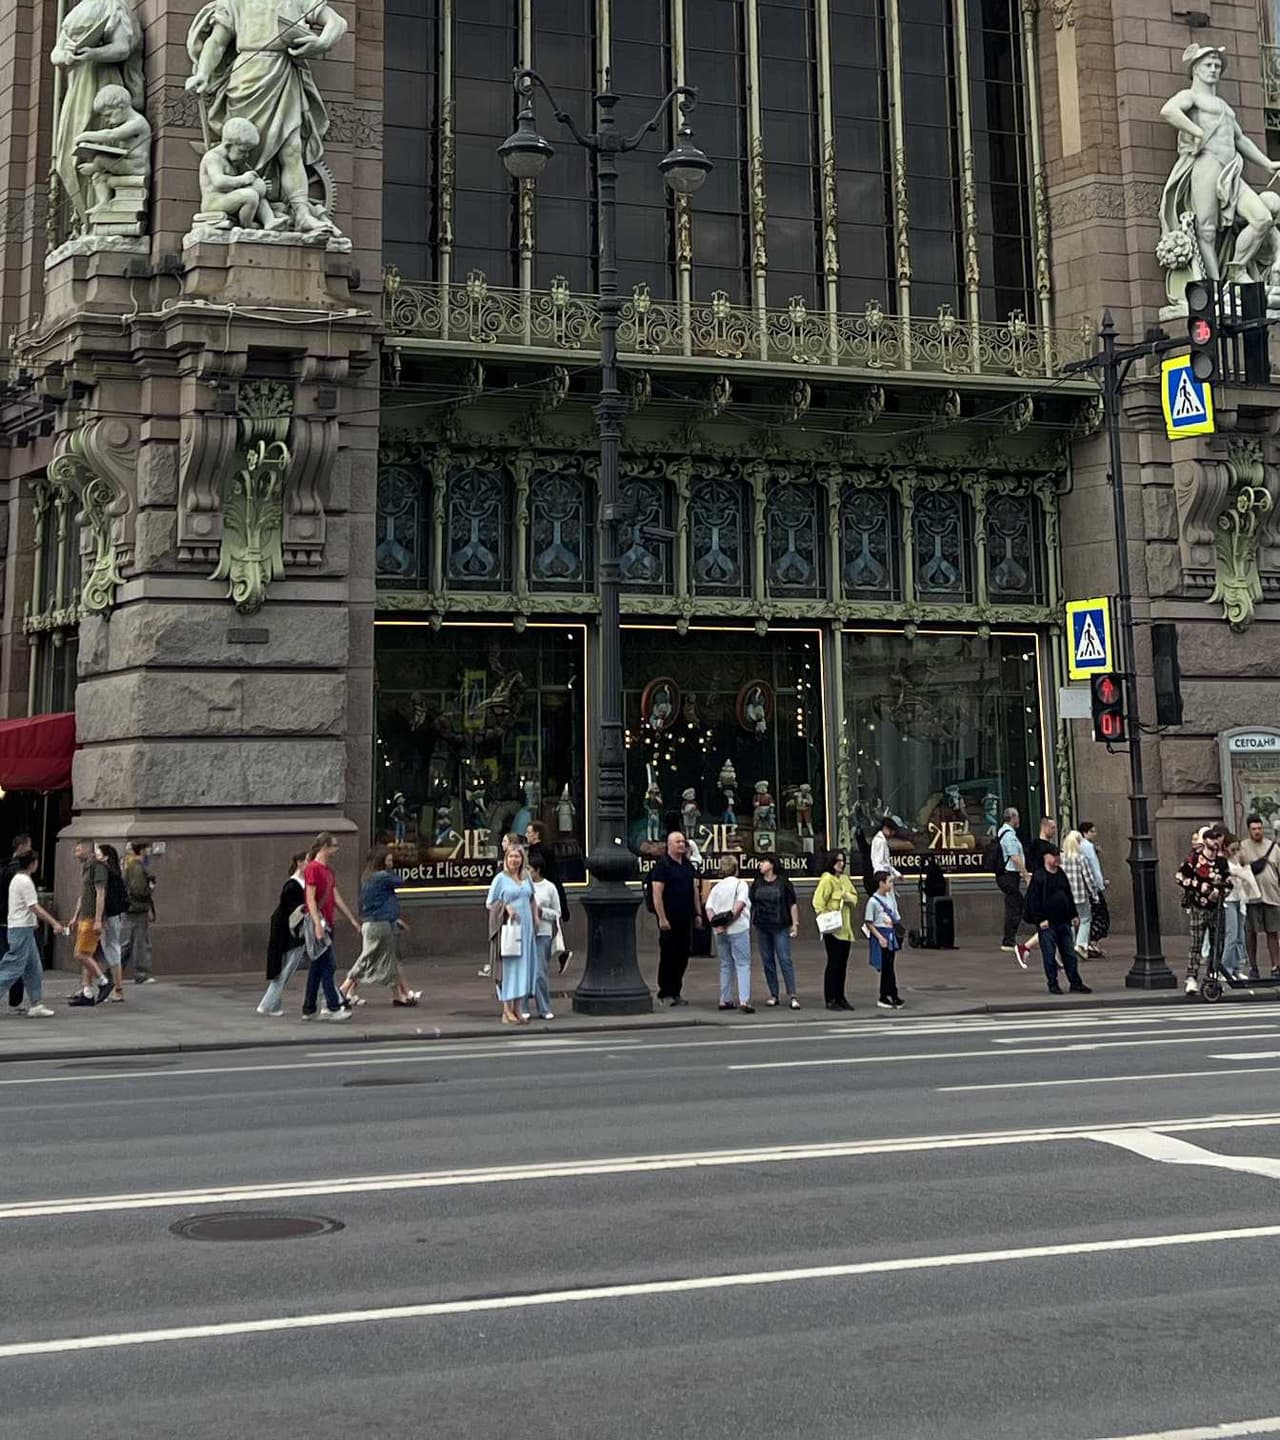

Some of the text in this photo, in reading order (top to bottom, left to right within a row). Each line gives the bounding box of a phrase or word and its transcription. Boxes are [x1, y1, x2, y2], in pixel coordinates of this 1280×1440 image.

[1234, 738, 1276, 748] СЕГОДНЯ
[393, 863, 433, 882] upetz
[436, 862, 494, 879] Eliseevs
